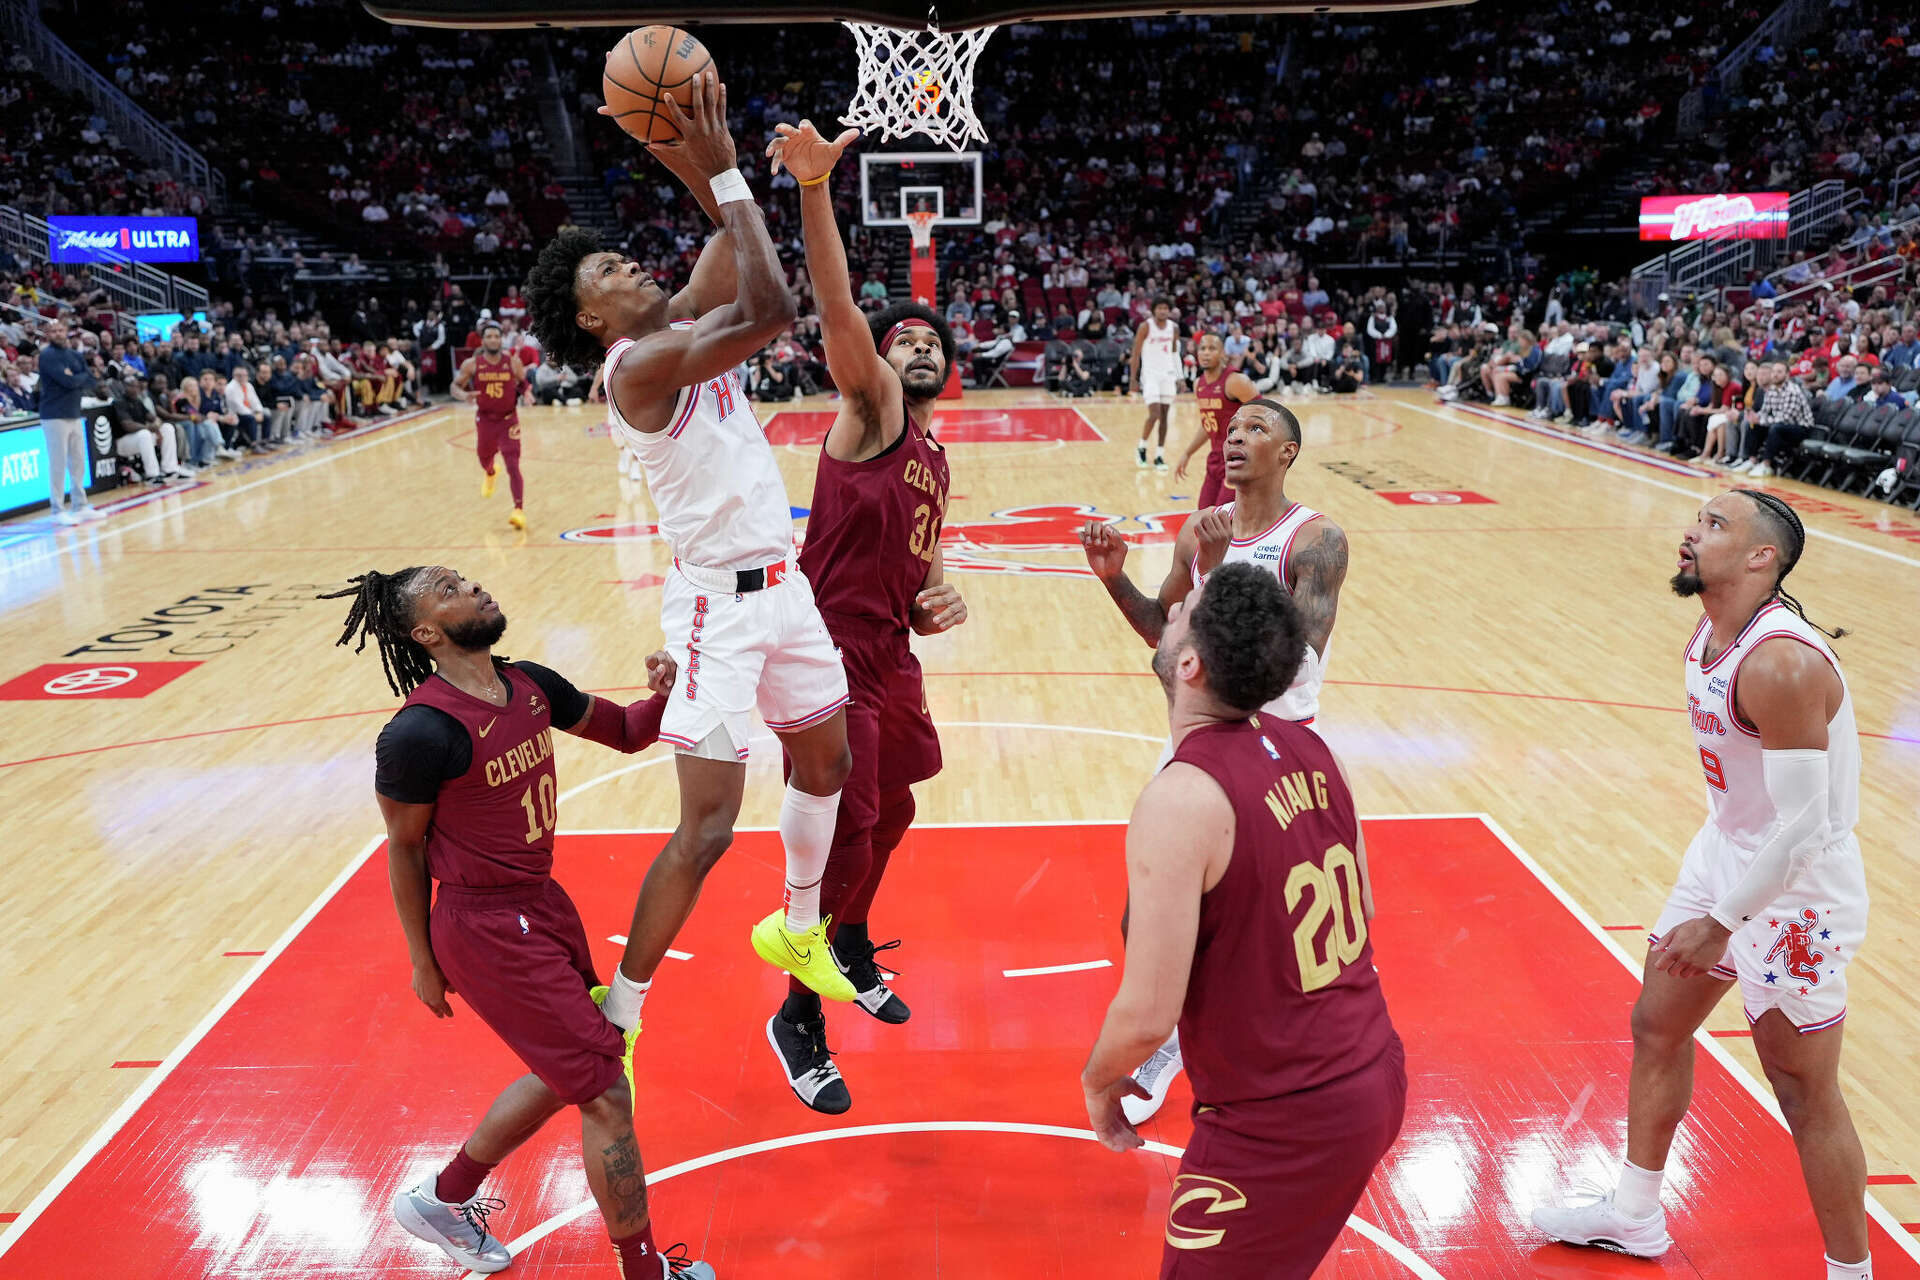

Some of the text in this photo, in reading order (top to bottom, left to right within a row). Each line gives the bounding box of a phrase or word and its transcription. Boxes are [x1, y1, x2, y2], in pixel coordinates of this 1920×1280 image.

[131, 230, 190, 249] ULTRA
[486, 382, 504, 398] 45
[1201, 411, 1218, 432] 35
[2, 449, 40, 487] AT&T
[95, 457, 116, 478] AT&T
[909, 503, 942, 563] 31
[1253, 551, 1279, 560] karma
[62, 584, 271, 657] TOYOTA
[168, 583, 346, 655] CENTER
[485, 726, 554, 787] CLEVELAN
[1699, 744, 1728, 793] 9
[521, 773, 556, 845] 10
[1264, 771, 1329, 831] NIANG
[1284, 843, 1368, 993] 20
